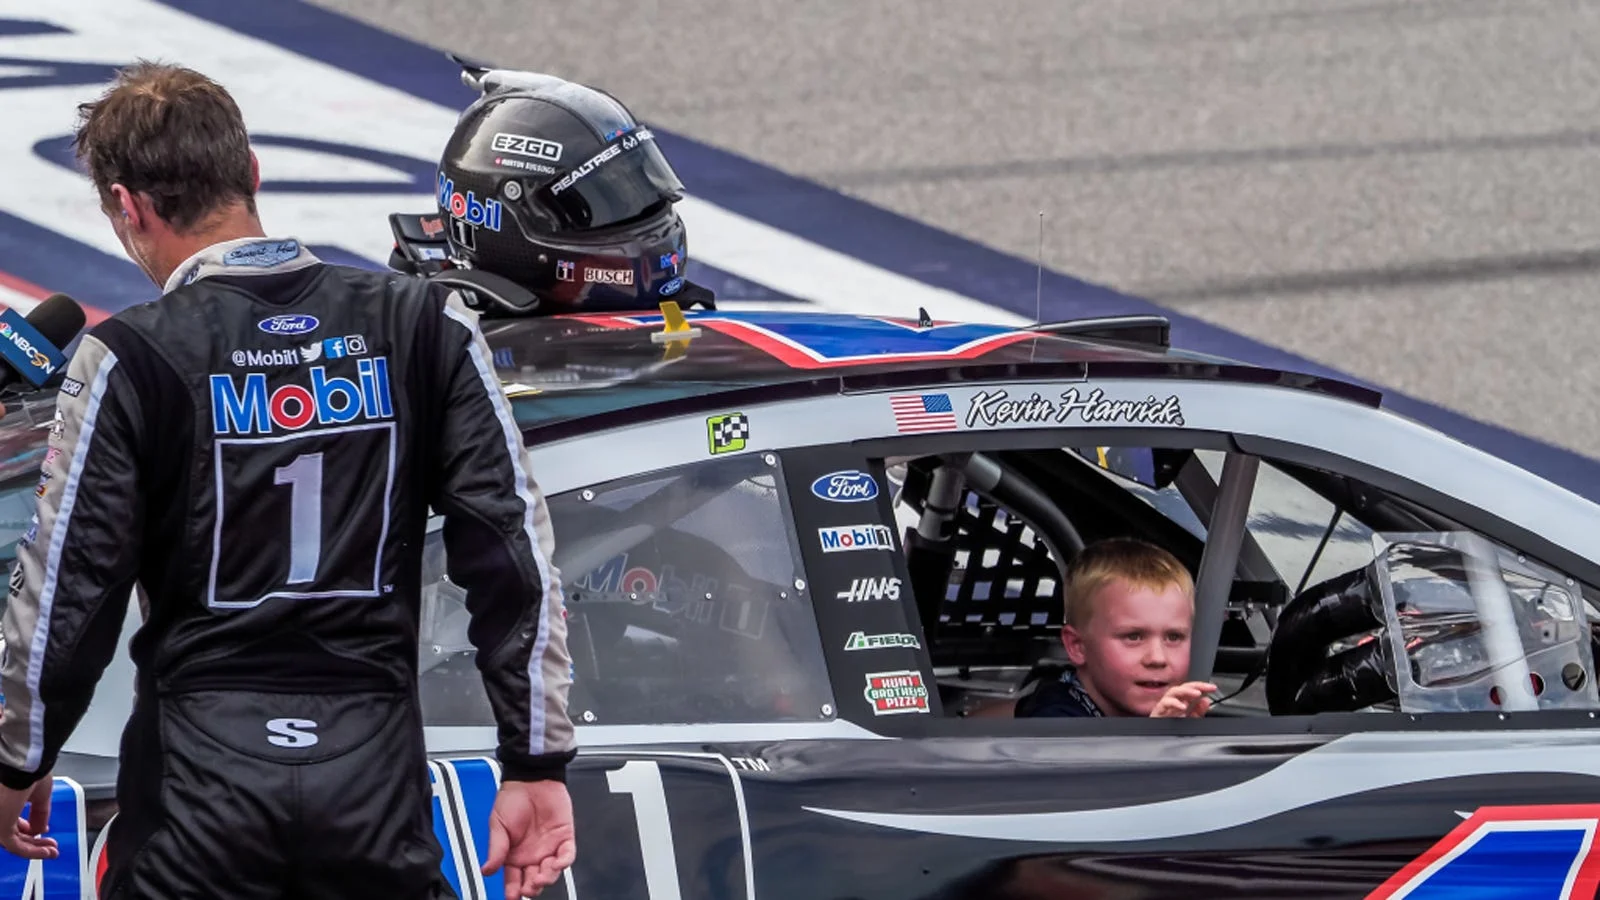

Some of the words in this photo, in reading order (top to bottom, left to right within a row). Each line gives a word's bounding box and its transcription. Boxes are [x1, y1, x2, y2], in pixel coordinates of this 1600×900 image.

[551, 143, 621, 196] REALTREE
[438, 171, 502, 232] Mobil
[584, 267, 633, 285] BUSCH
[270, 315, 306, 331] Ford
[9, 332, 55, 374] NBCSN
[232, 349, 299, 367] @Mobil1
[209, 356, 394, 434] Mobil
[966, 388, 1056, 428] Kevin
[1055, 387, 1180, 425] Harvick
[827, 474, 870, 498] Ford
[273, 452, 324, 585] 1
[880, 676, 914, 689] HUNT
[731, 757, 770, 772] TM
